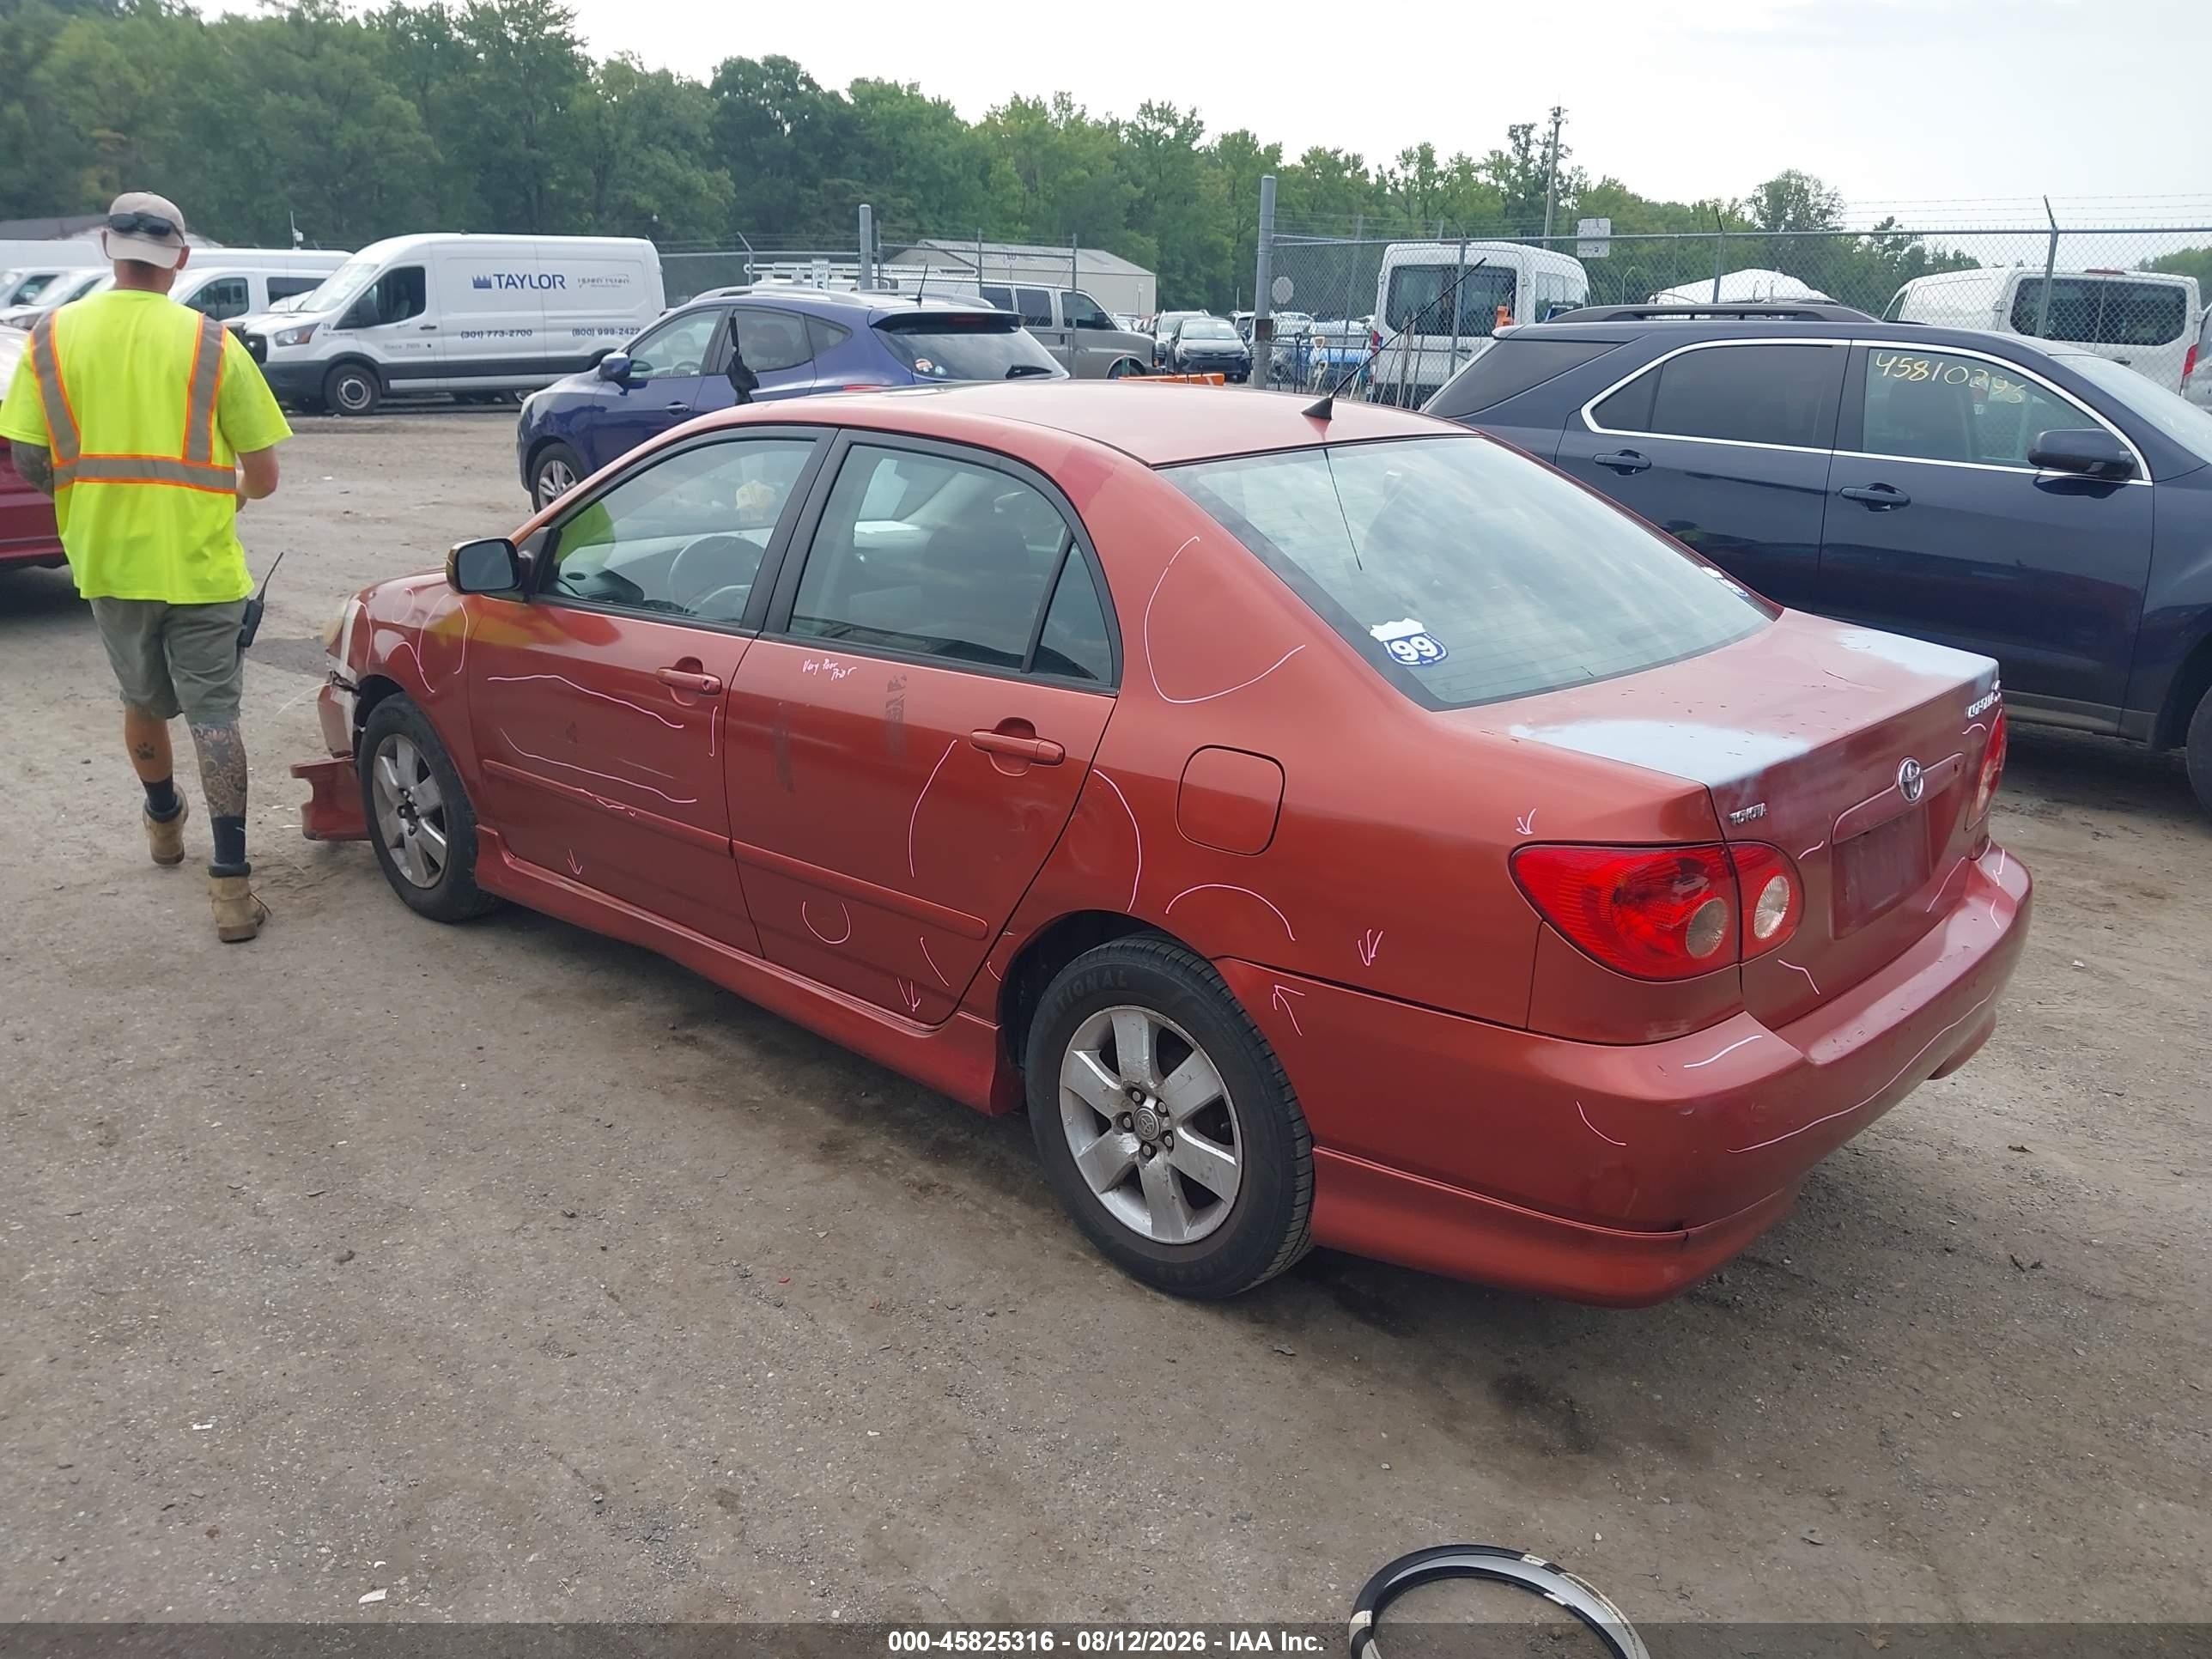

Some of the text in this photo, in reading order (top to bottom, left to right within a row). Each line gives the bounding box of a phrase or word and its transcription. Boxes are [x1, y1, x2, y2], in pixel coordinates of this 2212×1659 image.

[493, 273, 567, 289] TAYLOR
[460, 328, 533, 339] (301) 773-2700
[572, 327, 595, 337] (800)
[1390, 635, 1438, 662] 99
[1729, 802, 1768, 825] TOYOTA
